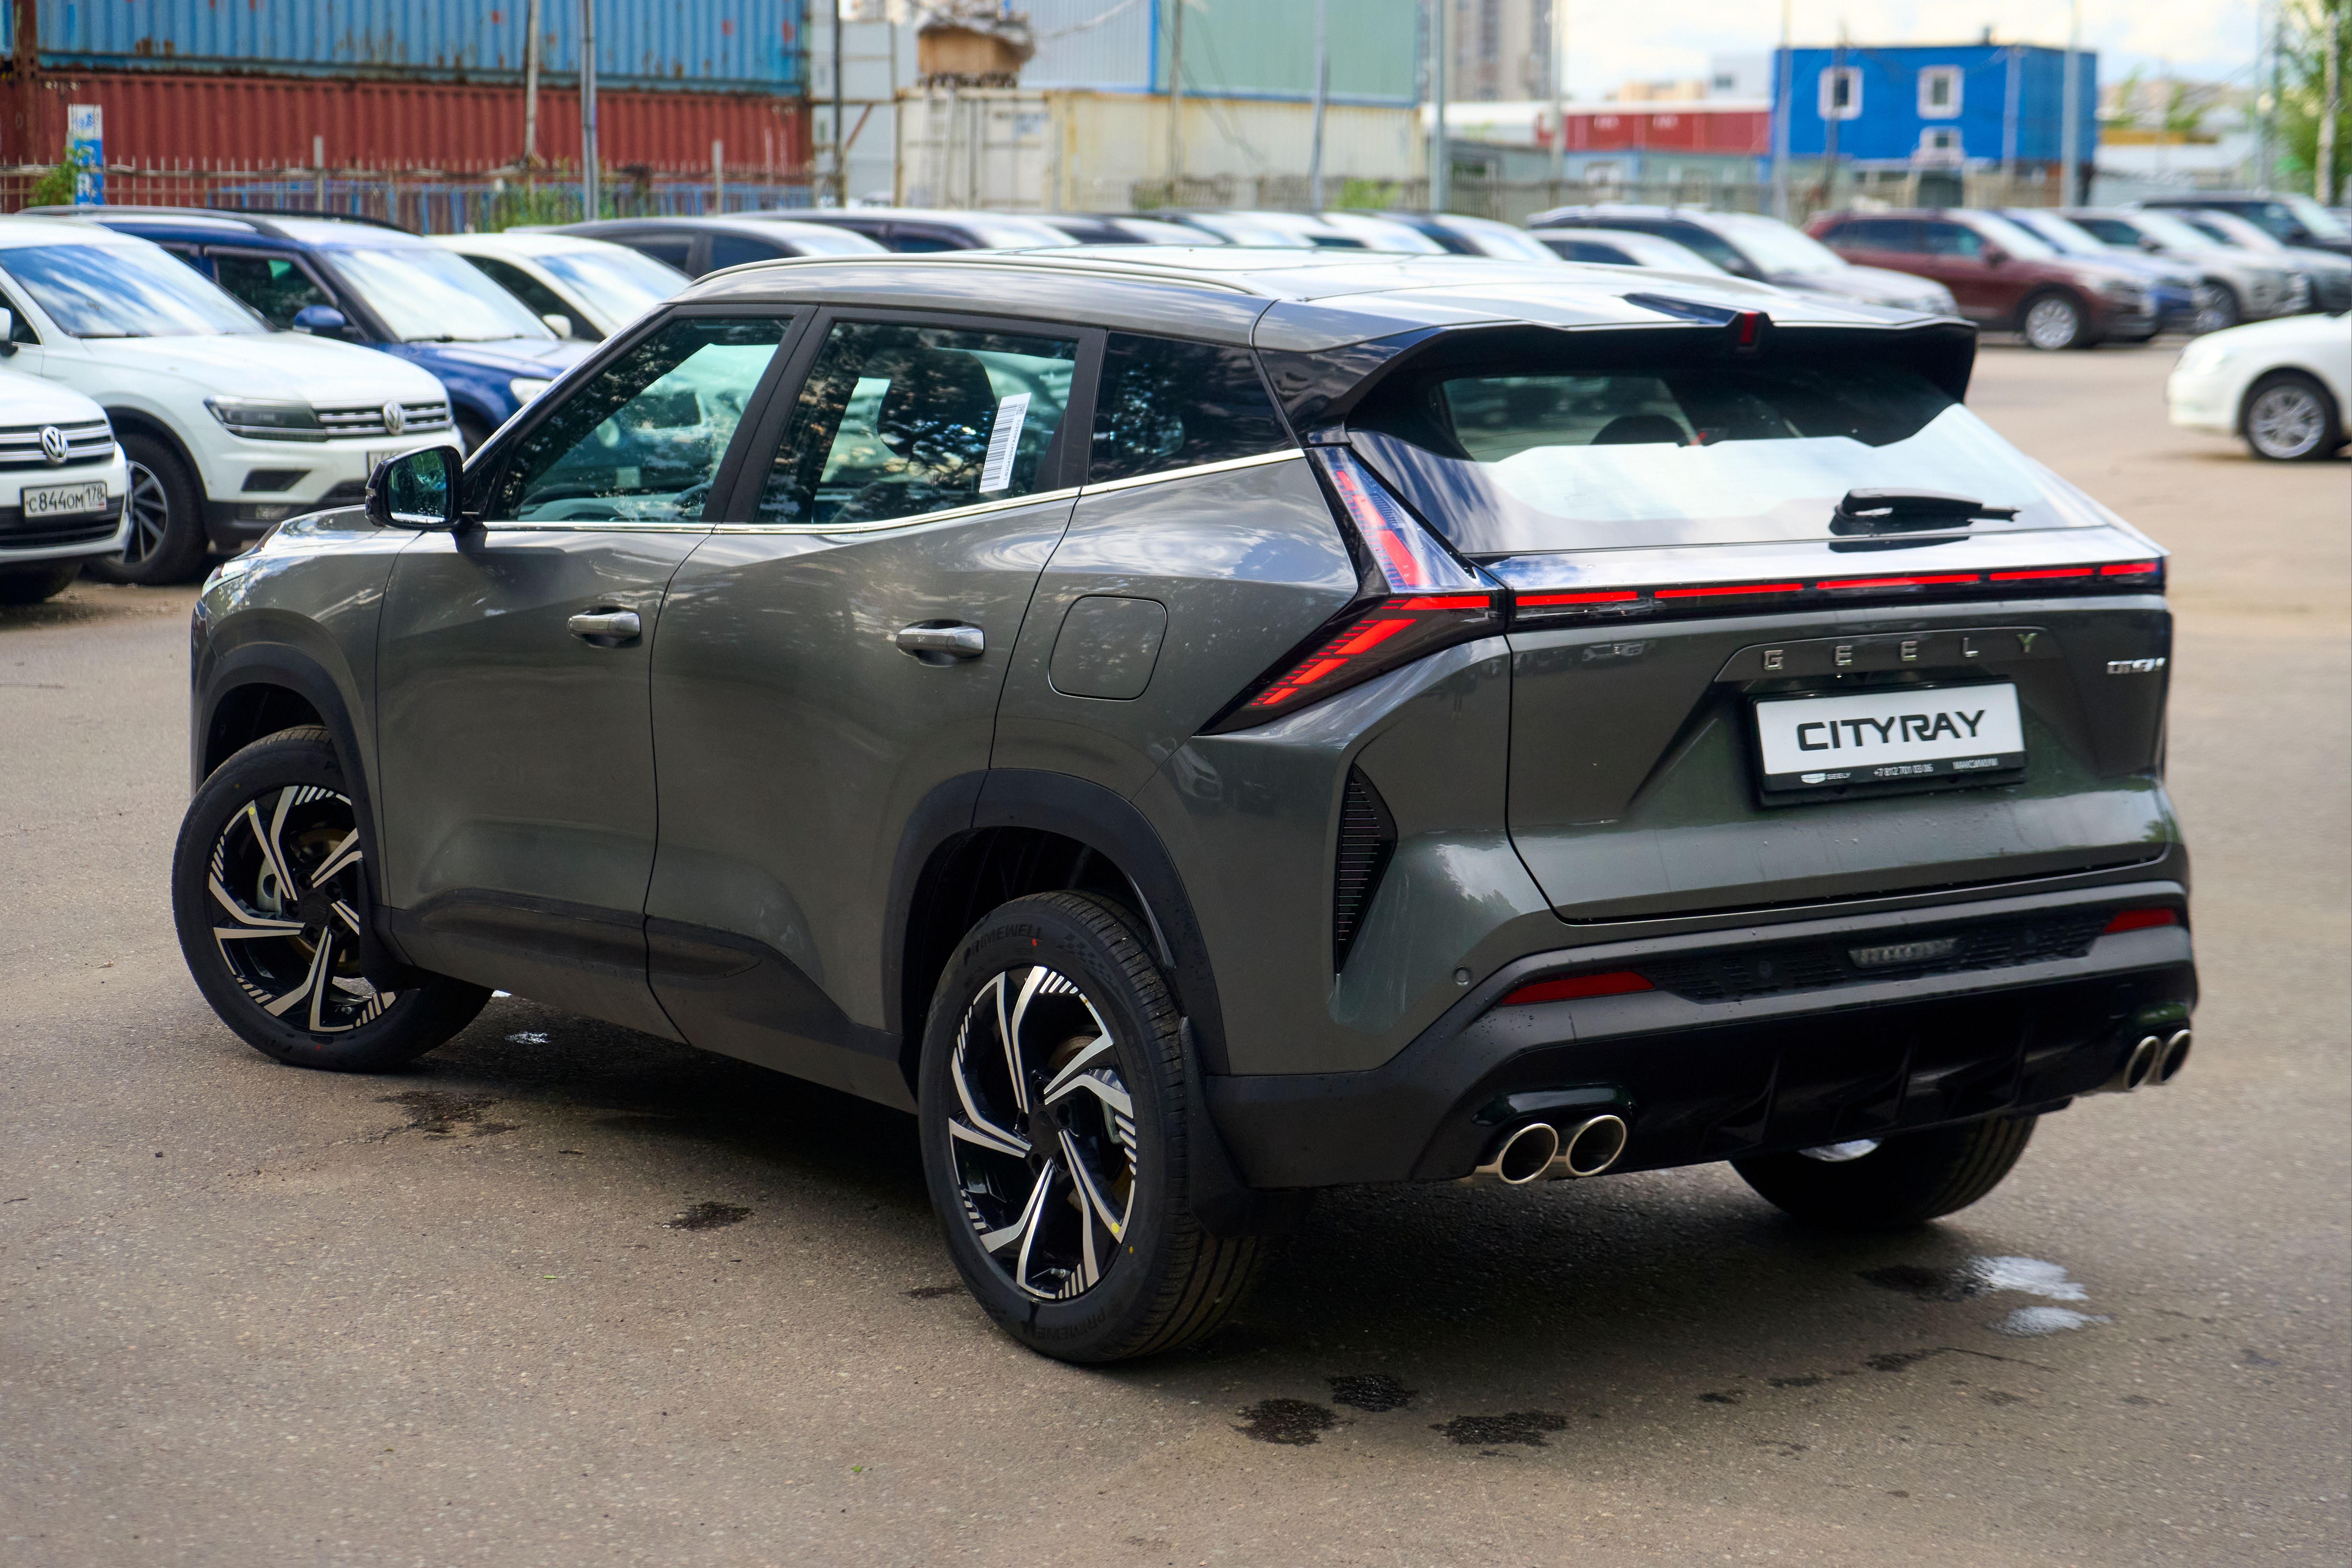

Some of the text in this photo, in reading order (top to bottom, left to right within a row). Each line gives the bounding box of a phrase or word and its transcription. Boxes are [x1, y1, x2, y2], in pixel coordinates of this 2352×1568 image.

[86, 485, 103, 501] 178
[1764, 632, 2037, 671] GEELY
[1797, 710, 1986, 751] CITYRAY
